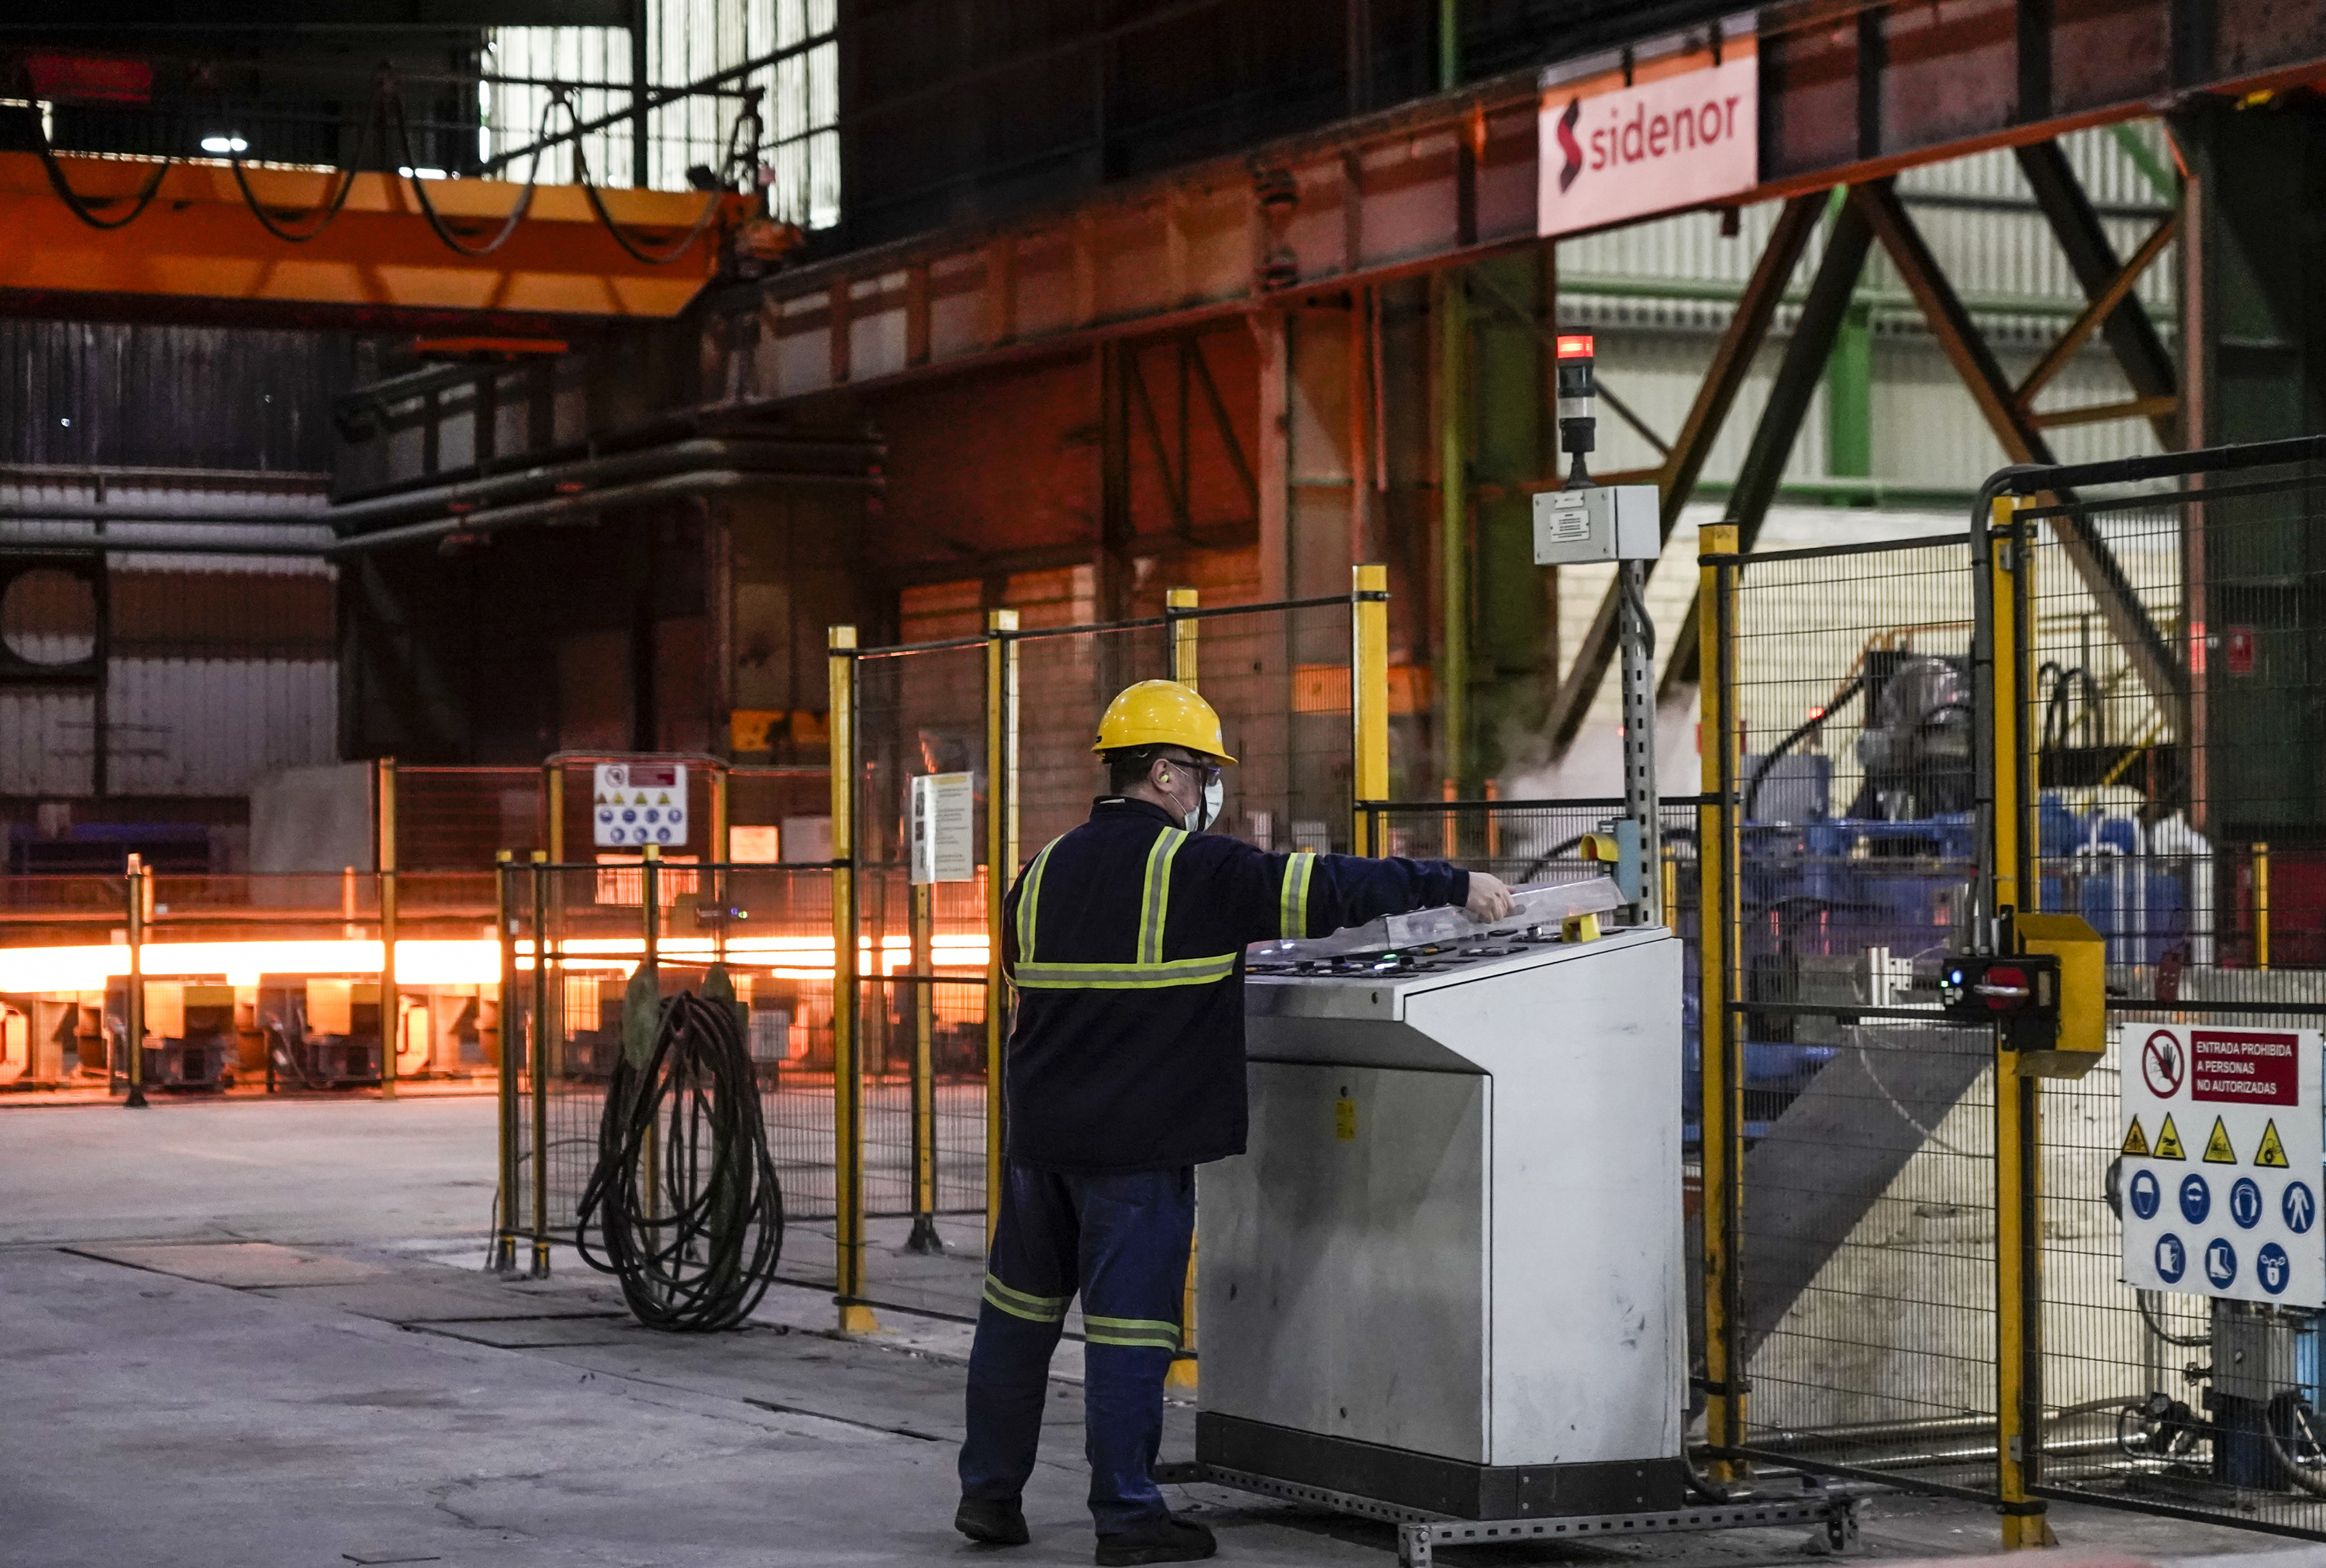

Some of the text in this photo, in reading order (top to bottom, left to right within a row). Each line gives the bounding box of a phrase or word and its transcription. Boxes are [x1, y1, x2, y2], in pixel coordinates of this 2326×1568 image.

[1591, 96, 1739, 171] sidenor
[2197, 1041, 2292, 1056] ENTRADA PROHIBIDA
[2197, 1060, 2255, 1074] A PERSONAS
[2197, 1079, 2276, 1094] NO AUTORIZADAS
